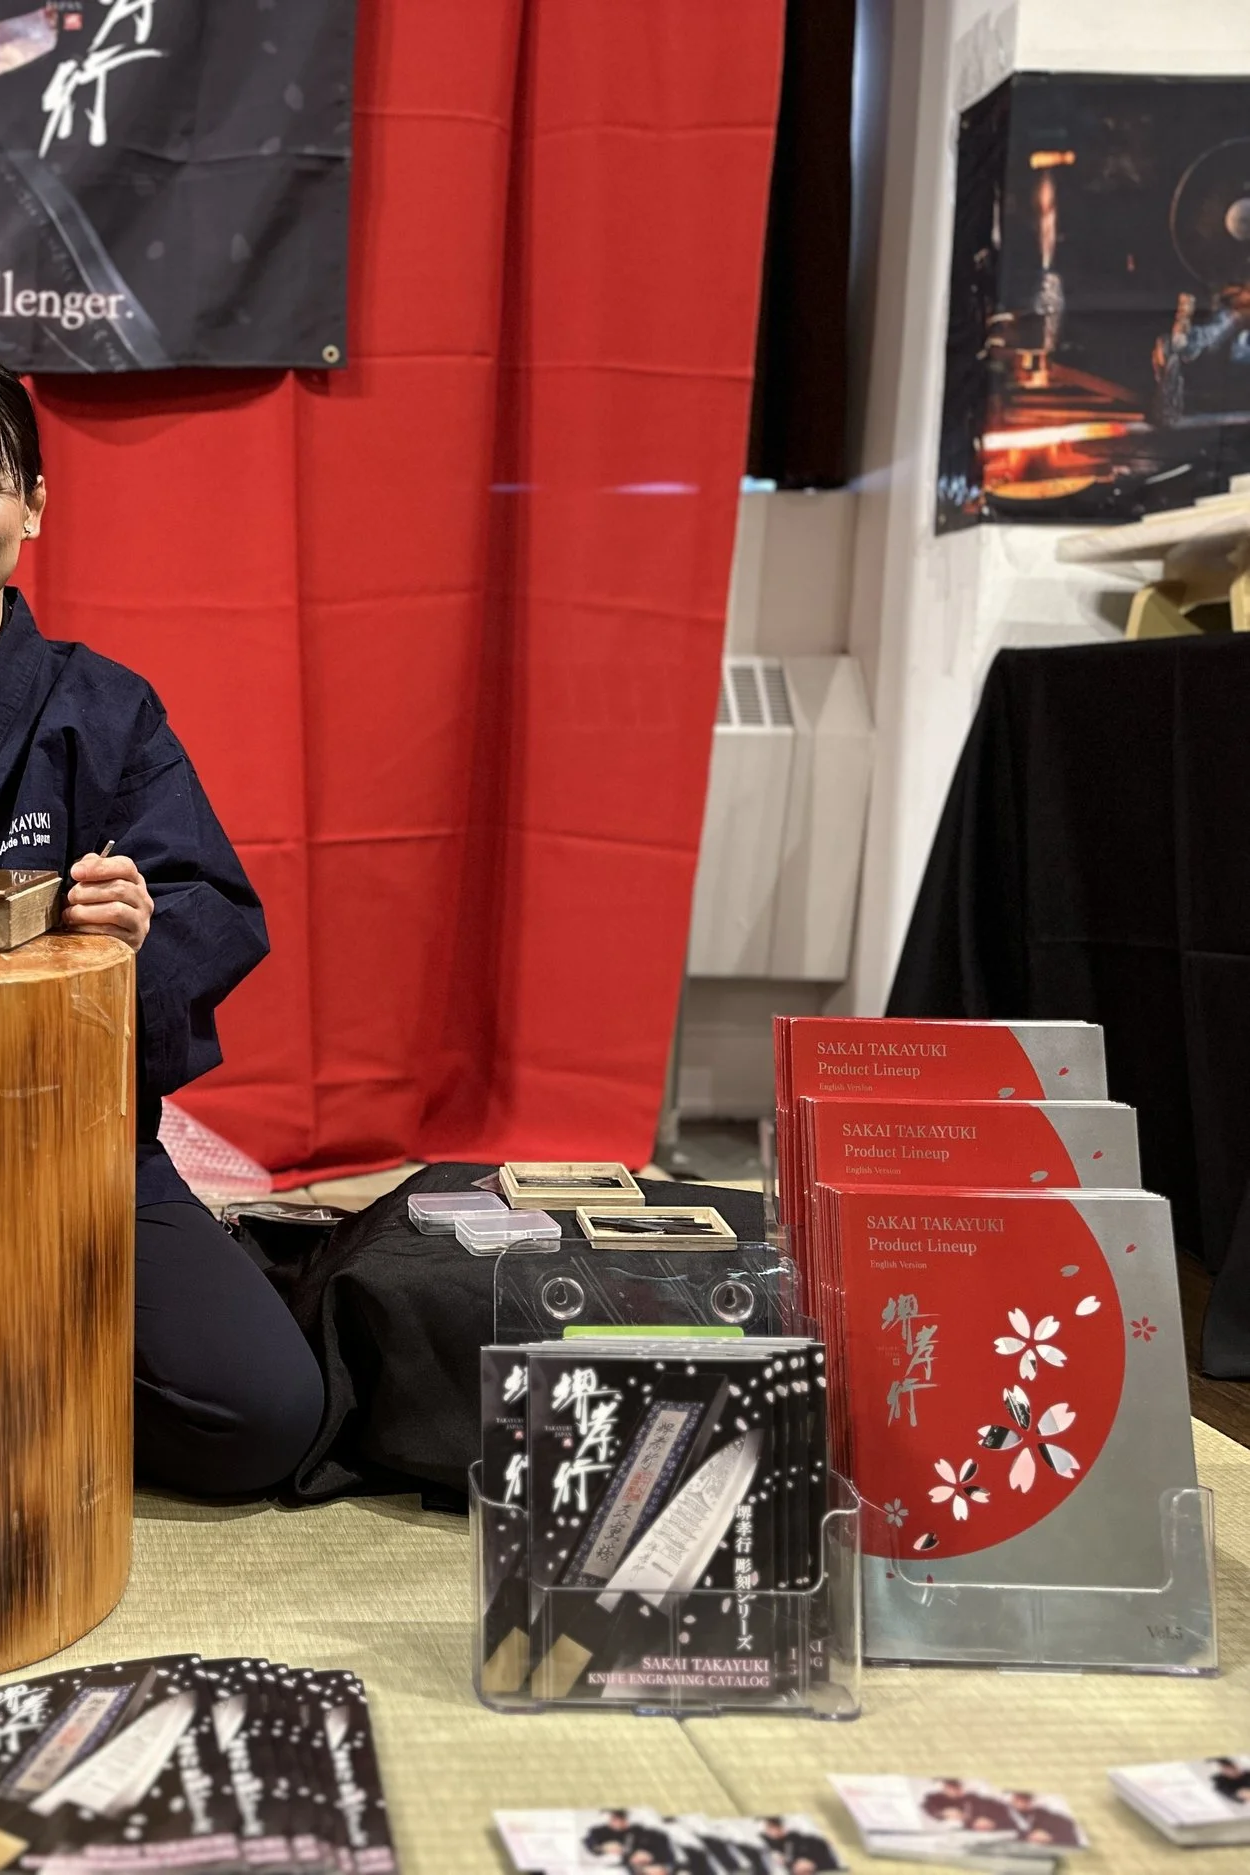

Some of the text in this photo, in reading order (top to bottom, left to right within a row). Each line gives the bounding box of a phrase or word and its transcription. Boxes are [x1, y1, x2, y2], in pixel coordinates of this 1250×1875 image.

[9, 812, 51, 835] KAYUKI
[817, 1041, 948, 1058] SAKAI TAKAYUKI
[818, 1062, 921, 1080] Product Lineup
[819, 1082, 873, 1092] English Version
[842, 1123, 978, 1140] SAKAI TAKAYUKI
[844, 1143, 950, 1163] Product Lineup
[845, 1165, 902, 1175] English Version
[867, 1215, 1006, 1233] SAKAI TAKAYUKI
[869, 1236, 978, 1257] Product Lineup
[870, 1259, 928, 1270] English Version
[643, 1657, 771, 1673] SAKAI TAKAYUKI
[588, 1672, 770, 1687] KNIFE ENGRAVING CATALOG
